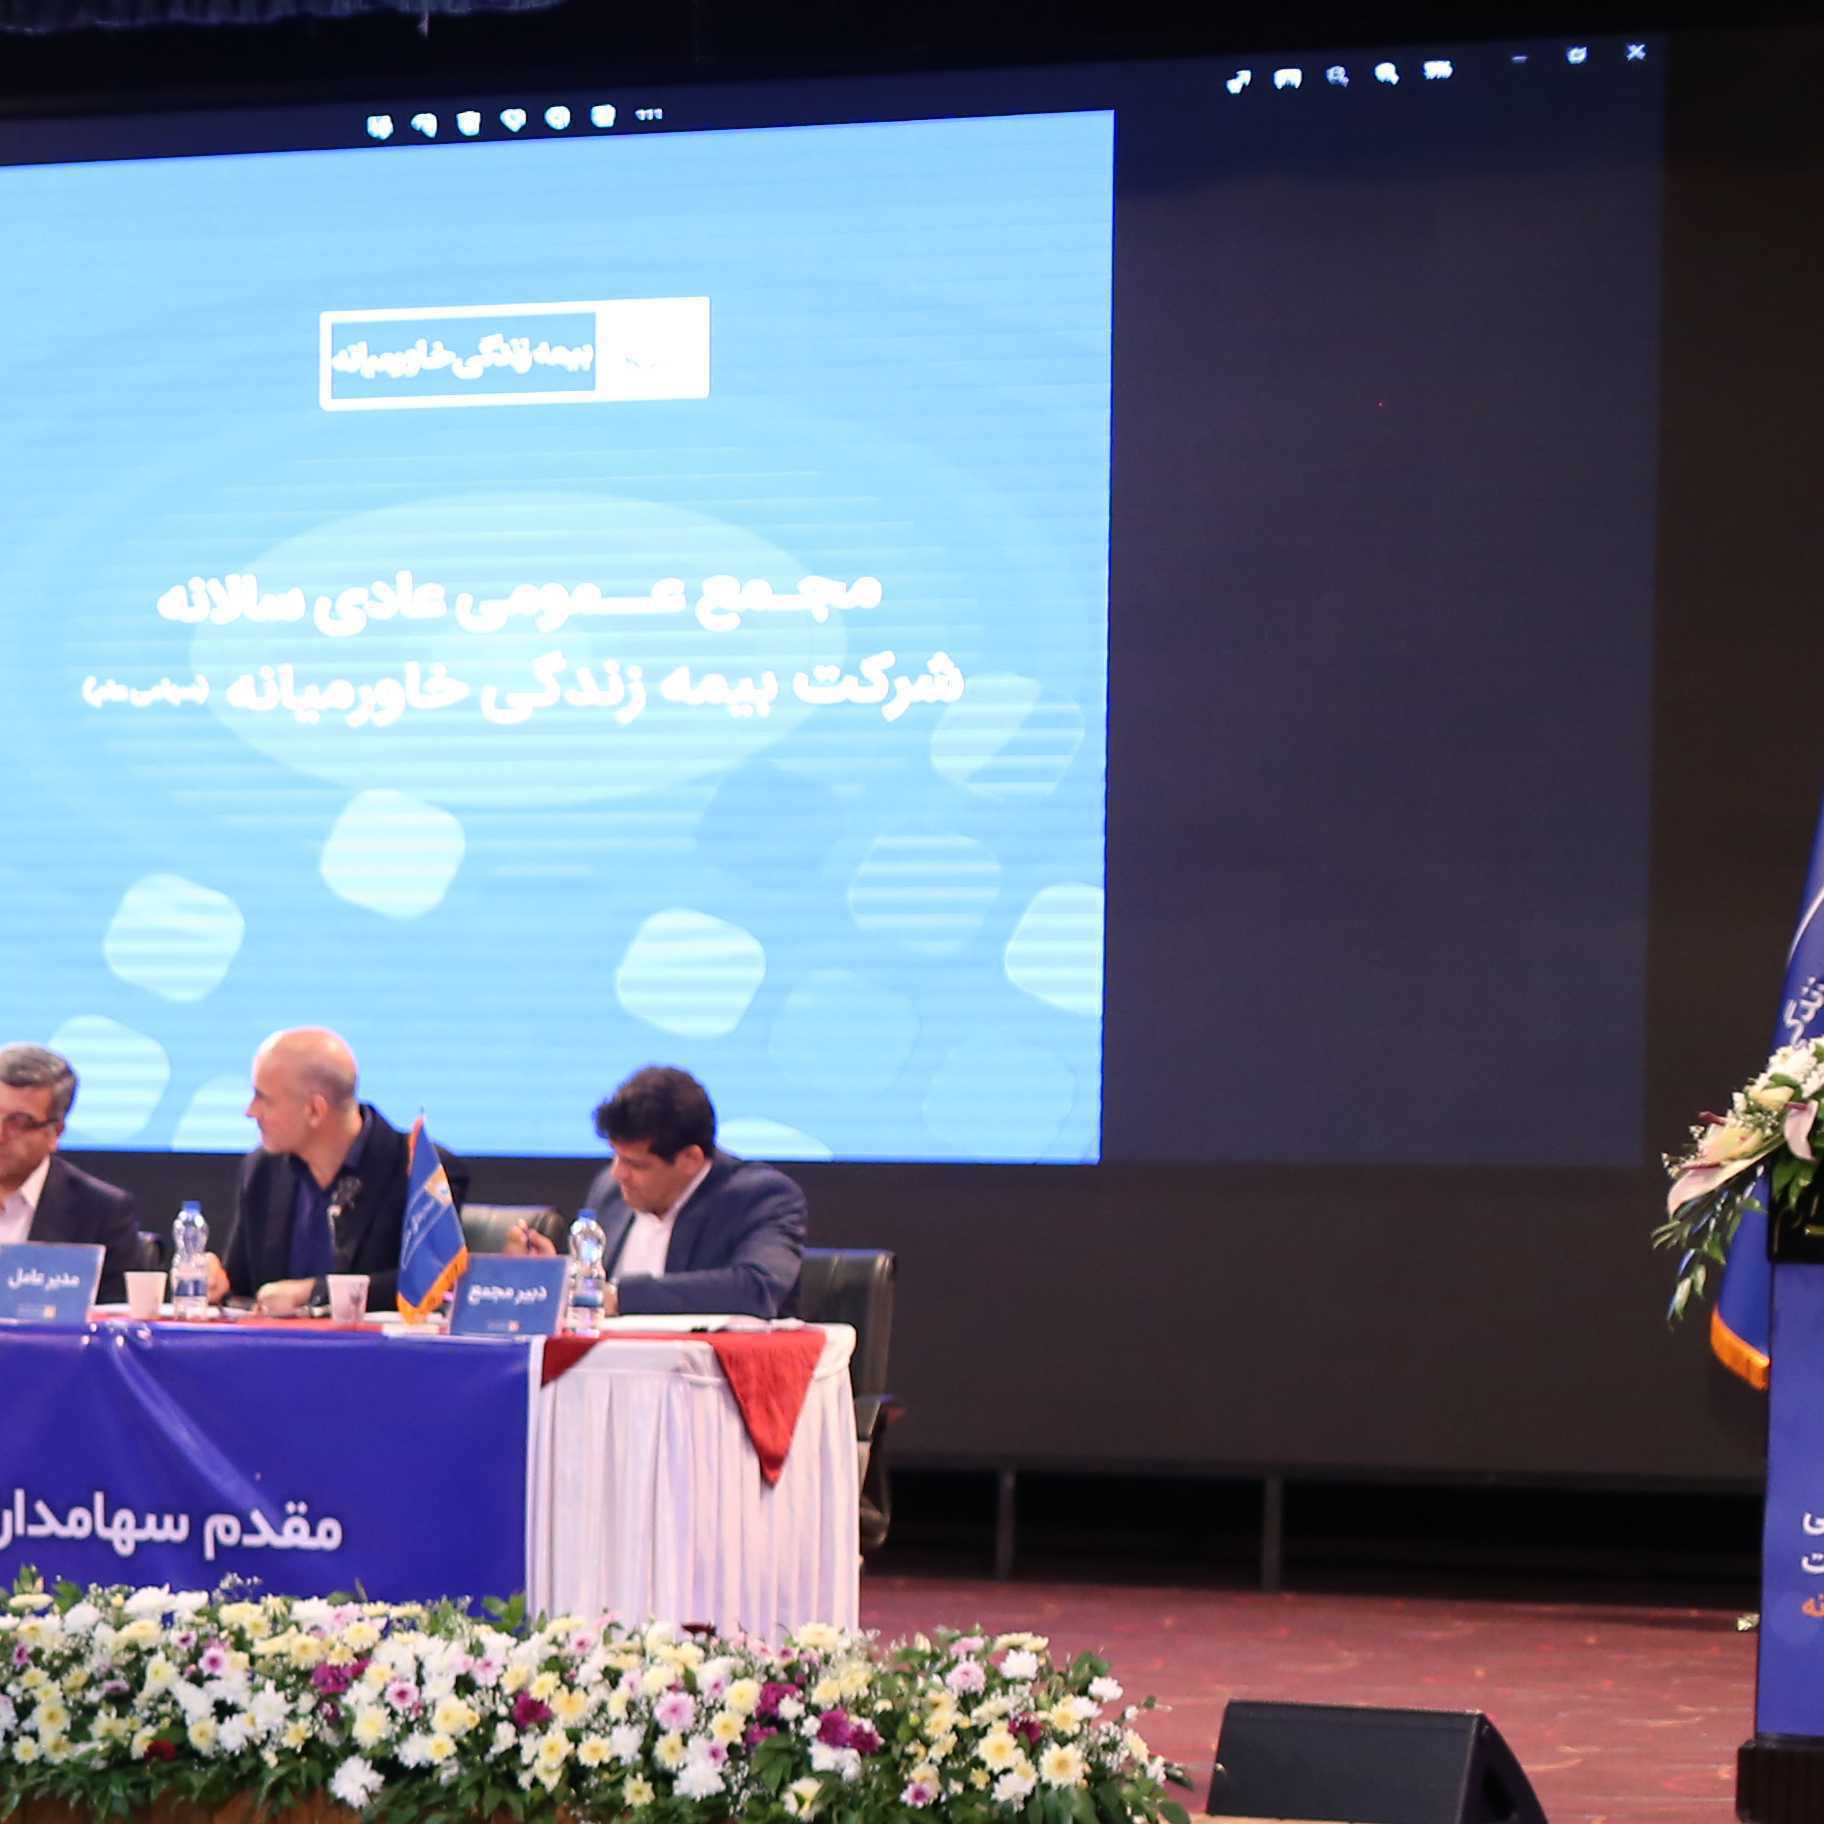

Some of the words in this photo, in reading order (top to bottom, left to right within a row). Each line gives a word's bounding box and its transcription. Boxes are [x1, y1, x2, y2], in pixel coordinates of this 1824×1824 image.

[156, 572, 306, 625] سالانه
[312, 570, 448, 637] عادی
[455, 576, 687, 634] عمومی
[694, 574, 883, 632] مجمع
[225, 660, 470, 728] خاورمیانه
[480, 650, 648, 725] زندگی
[660, 666, 779, 718] بیمه
[792, 650, 965, 722] شرکت
[7, 1267, 45, 1291] عامل
[467, 1284, 514, 1307] مجمع
[203, 1500, 343, 1561] مقدم
